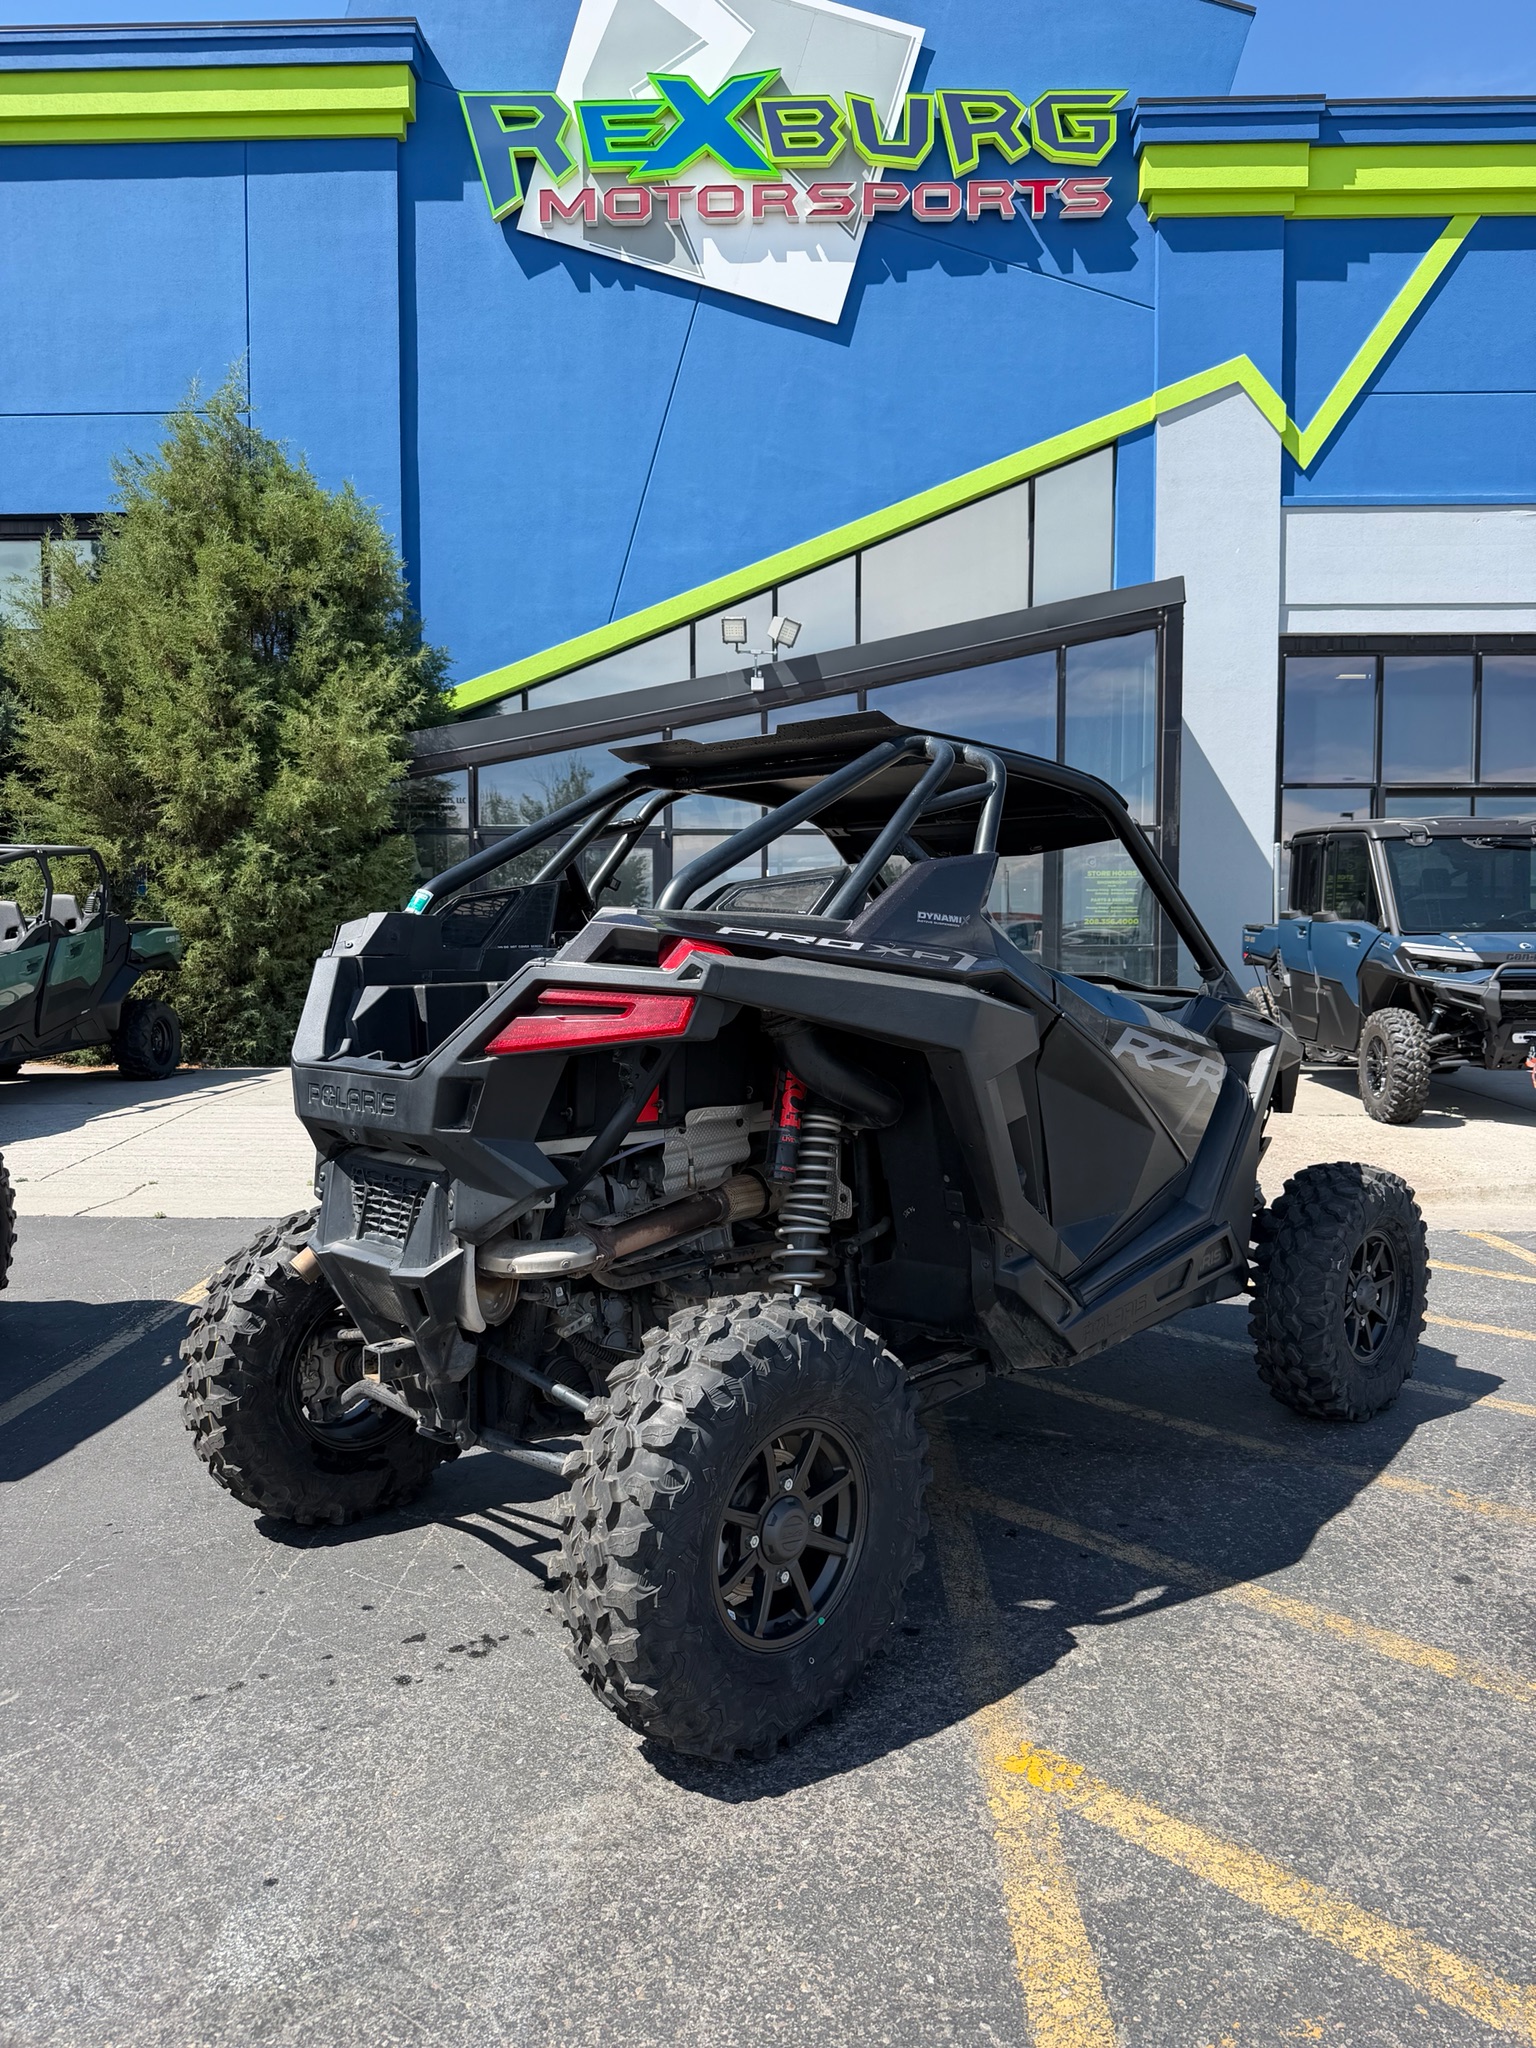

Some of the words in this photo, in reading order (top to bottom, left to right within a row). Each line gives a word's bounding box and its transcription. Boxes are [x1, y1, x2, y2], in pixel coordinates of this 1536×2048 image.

[458, 68, 1129, 223] REXBURG
[539, 177, 1112, 228] MOTORSPORTS
[716, 926, 865, 950] PRO
[917, 910, 970, 926] DYNAMIX
[1110, 1027, 1227, 1095] RZR
[307, 1082, 398, 1117] POLARIS
